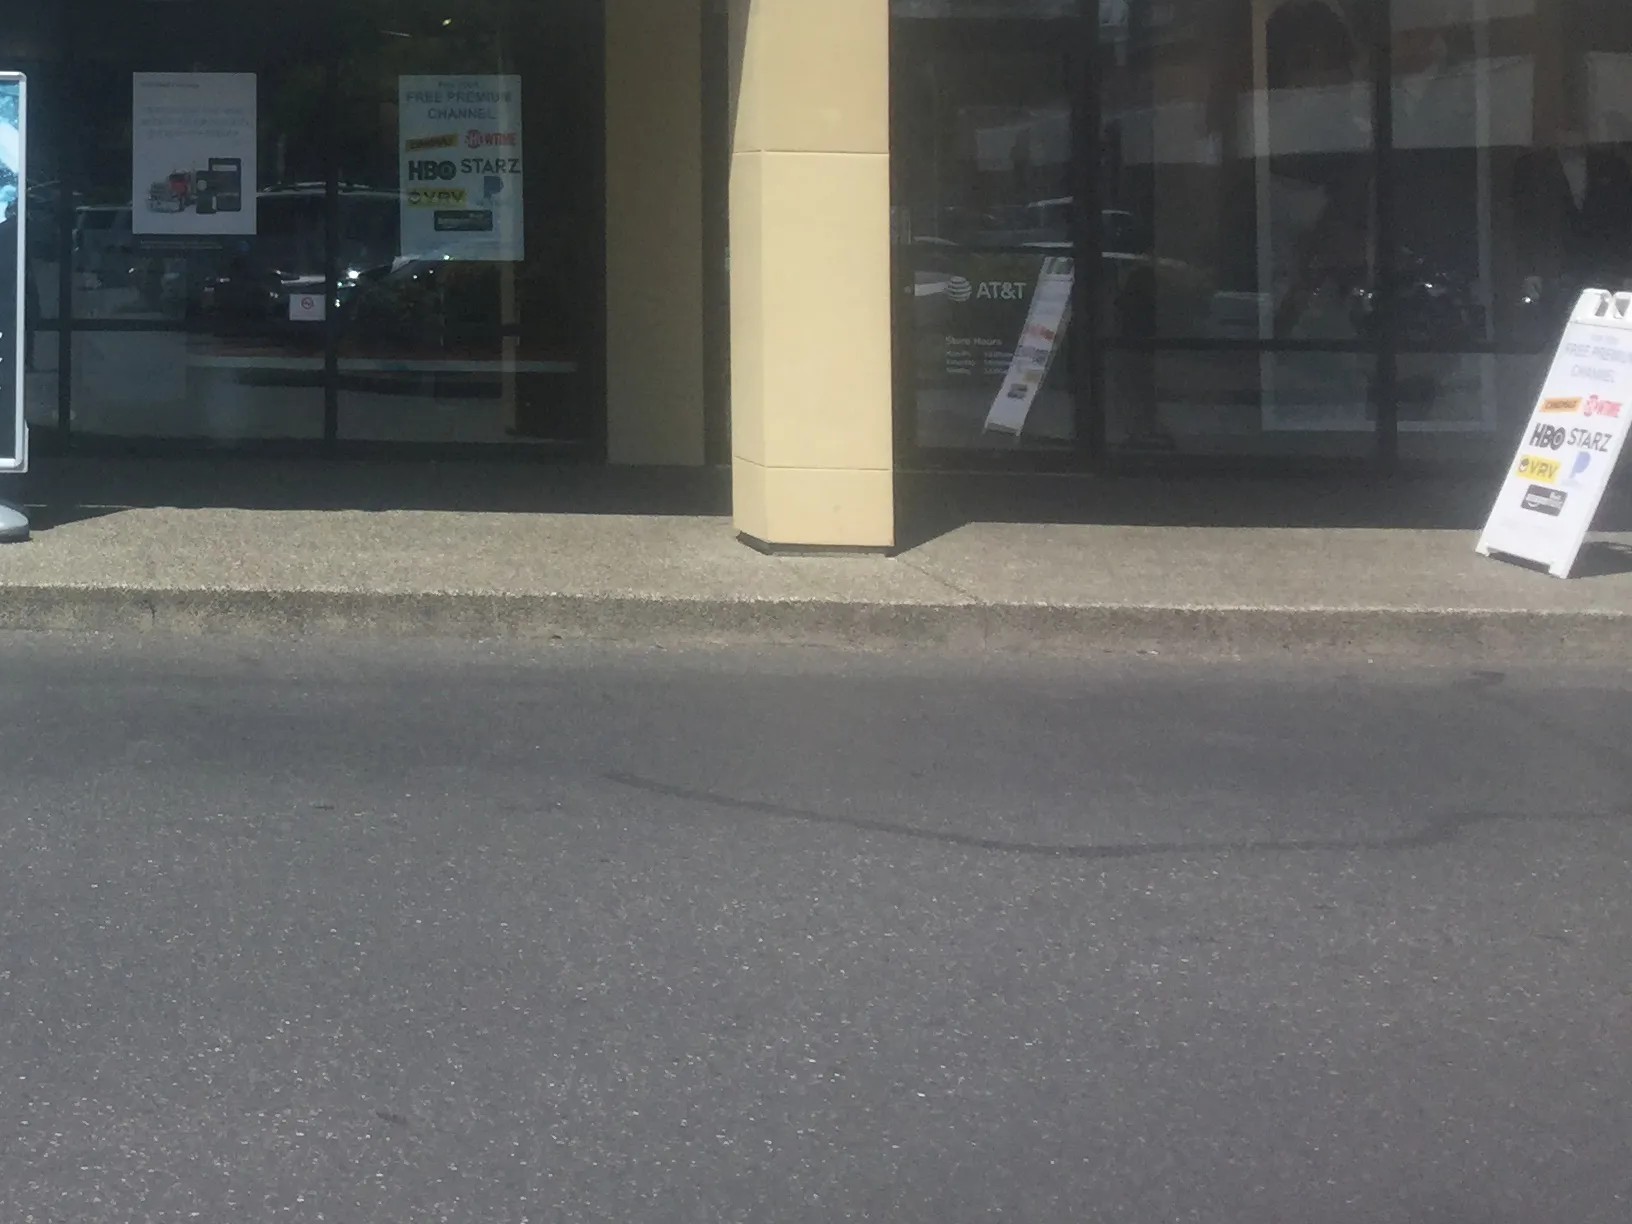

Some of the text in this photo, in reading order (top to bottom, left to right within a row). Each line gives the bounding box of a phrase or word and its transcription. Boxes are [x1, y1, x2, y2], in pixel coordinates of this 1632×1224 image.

[406, 91, 441, 103] FREE
[427, 108, 497, 120] CHANNEL
[408, 160, 456, 181] HBO
[460, 158, 521, 175] STARZ
[976, 281, 1027, 300] AT&T
[1529, 423, 1566, 450] HBO
[1567, 428, 1613, 452] STARZ
[1530, 460, 1559, 478] VRV
